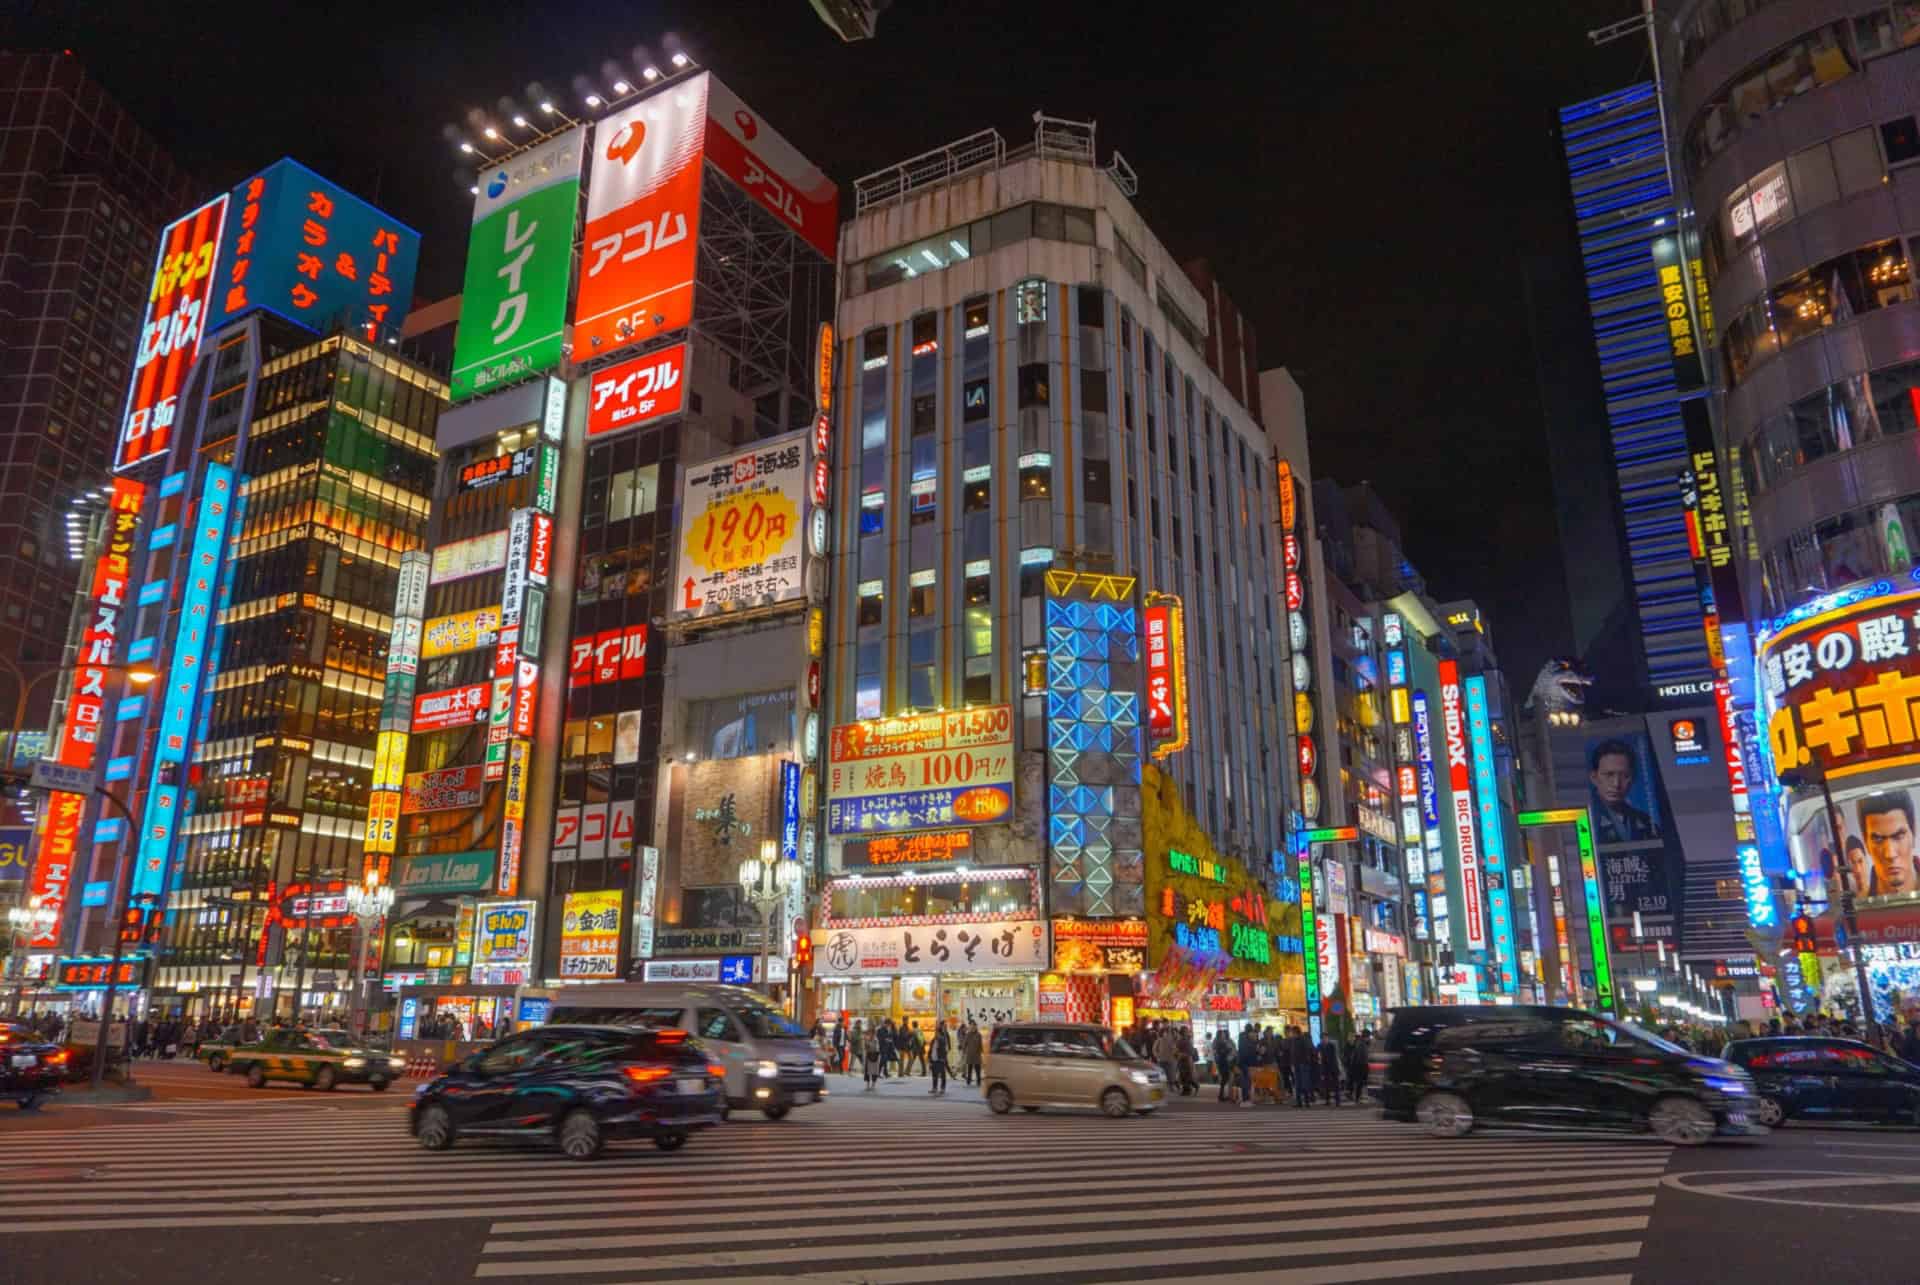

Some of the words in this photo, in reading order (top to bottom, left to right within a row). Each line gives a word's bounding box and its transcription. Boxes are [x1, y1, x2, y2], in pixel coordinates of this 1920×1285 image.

[743, 158, 804, 227] アコム
[588, 211, 688, 277] アコム
[491, 209, 538, 345] レイク
[594, 361, 679, 411] アイフル
[703, 501, 786, 553] 190円
[80, 577, 124, 698] エスパス
[573, 633, 647, 668] アイフル
[1659, 681, 1698, 697] HOTEL
[1442, 684, 1468, 767] SHIDAX
[554, 812, 633, 845] アコム
[1456, 799, 1470, 819] BIC
[1460, 825, 1475, 865] DRUG
[579, 909, 619, 932] 金の蔵
[903, 926, 1022, 963] とらそば
